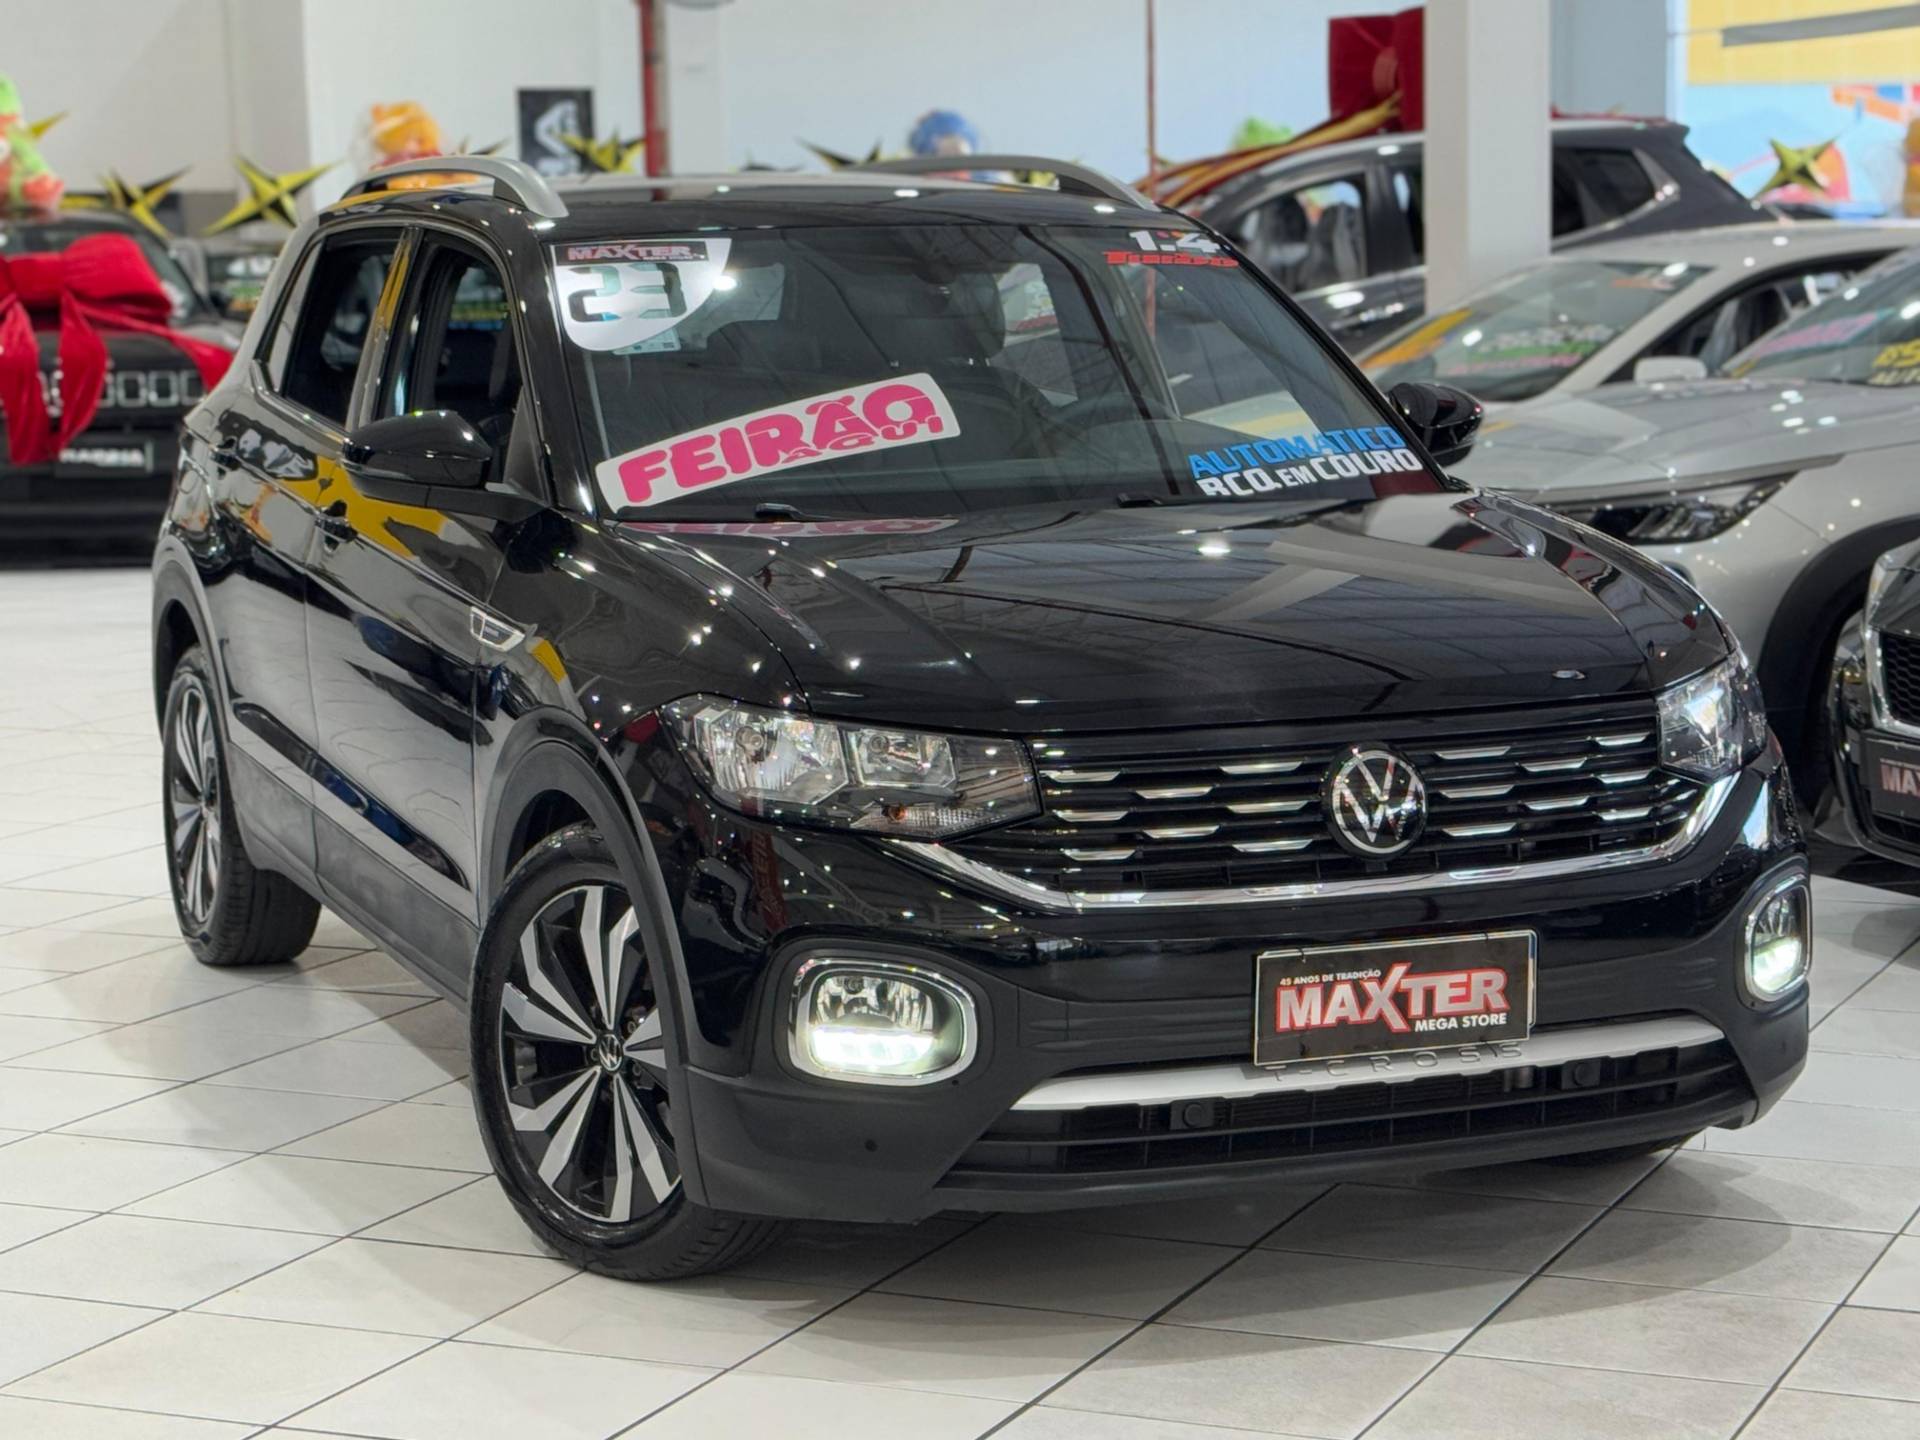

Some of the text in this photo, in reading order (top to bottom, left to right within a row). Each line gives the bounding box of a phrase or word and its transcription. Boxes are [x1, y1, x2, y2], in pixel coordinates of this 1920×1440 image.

[567, 243, 692, 261] MAXTER
[1129, 231, 1221, 253] 1.4
[568, 262, 688, 322] 23
[618, 384, 936, 503] FEIRÃO
[1275, 466, 1317, 488] EM
[1309, 449, 1424, 481] COURO
[1279, 968, 1382, 986] 45 ANOS DE TRADIÇÃO
[1276, 962, 1511, 1033] MAXTER
[1415, 1013, 1507, 1033] MEGA STORE
[1264, 1041, 1523, 1082] T-CROSS
